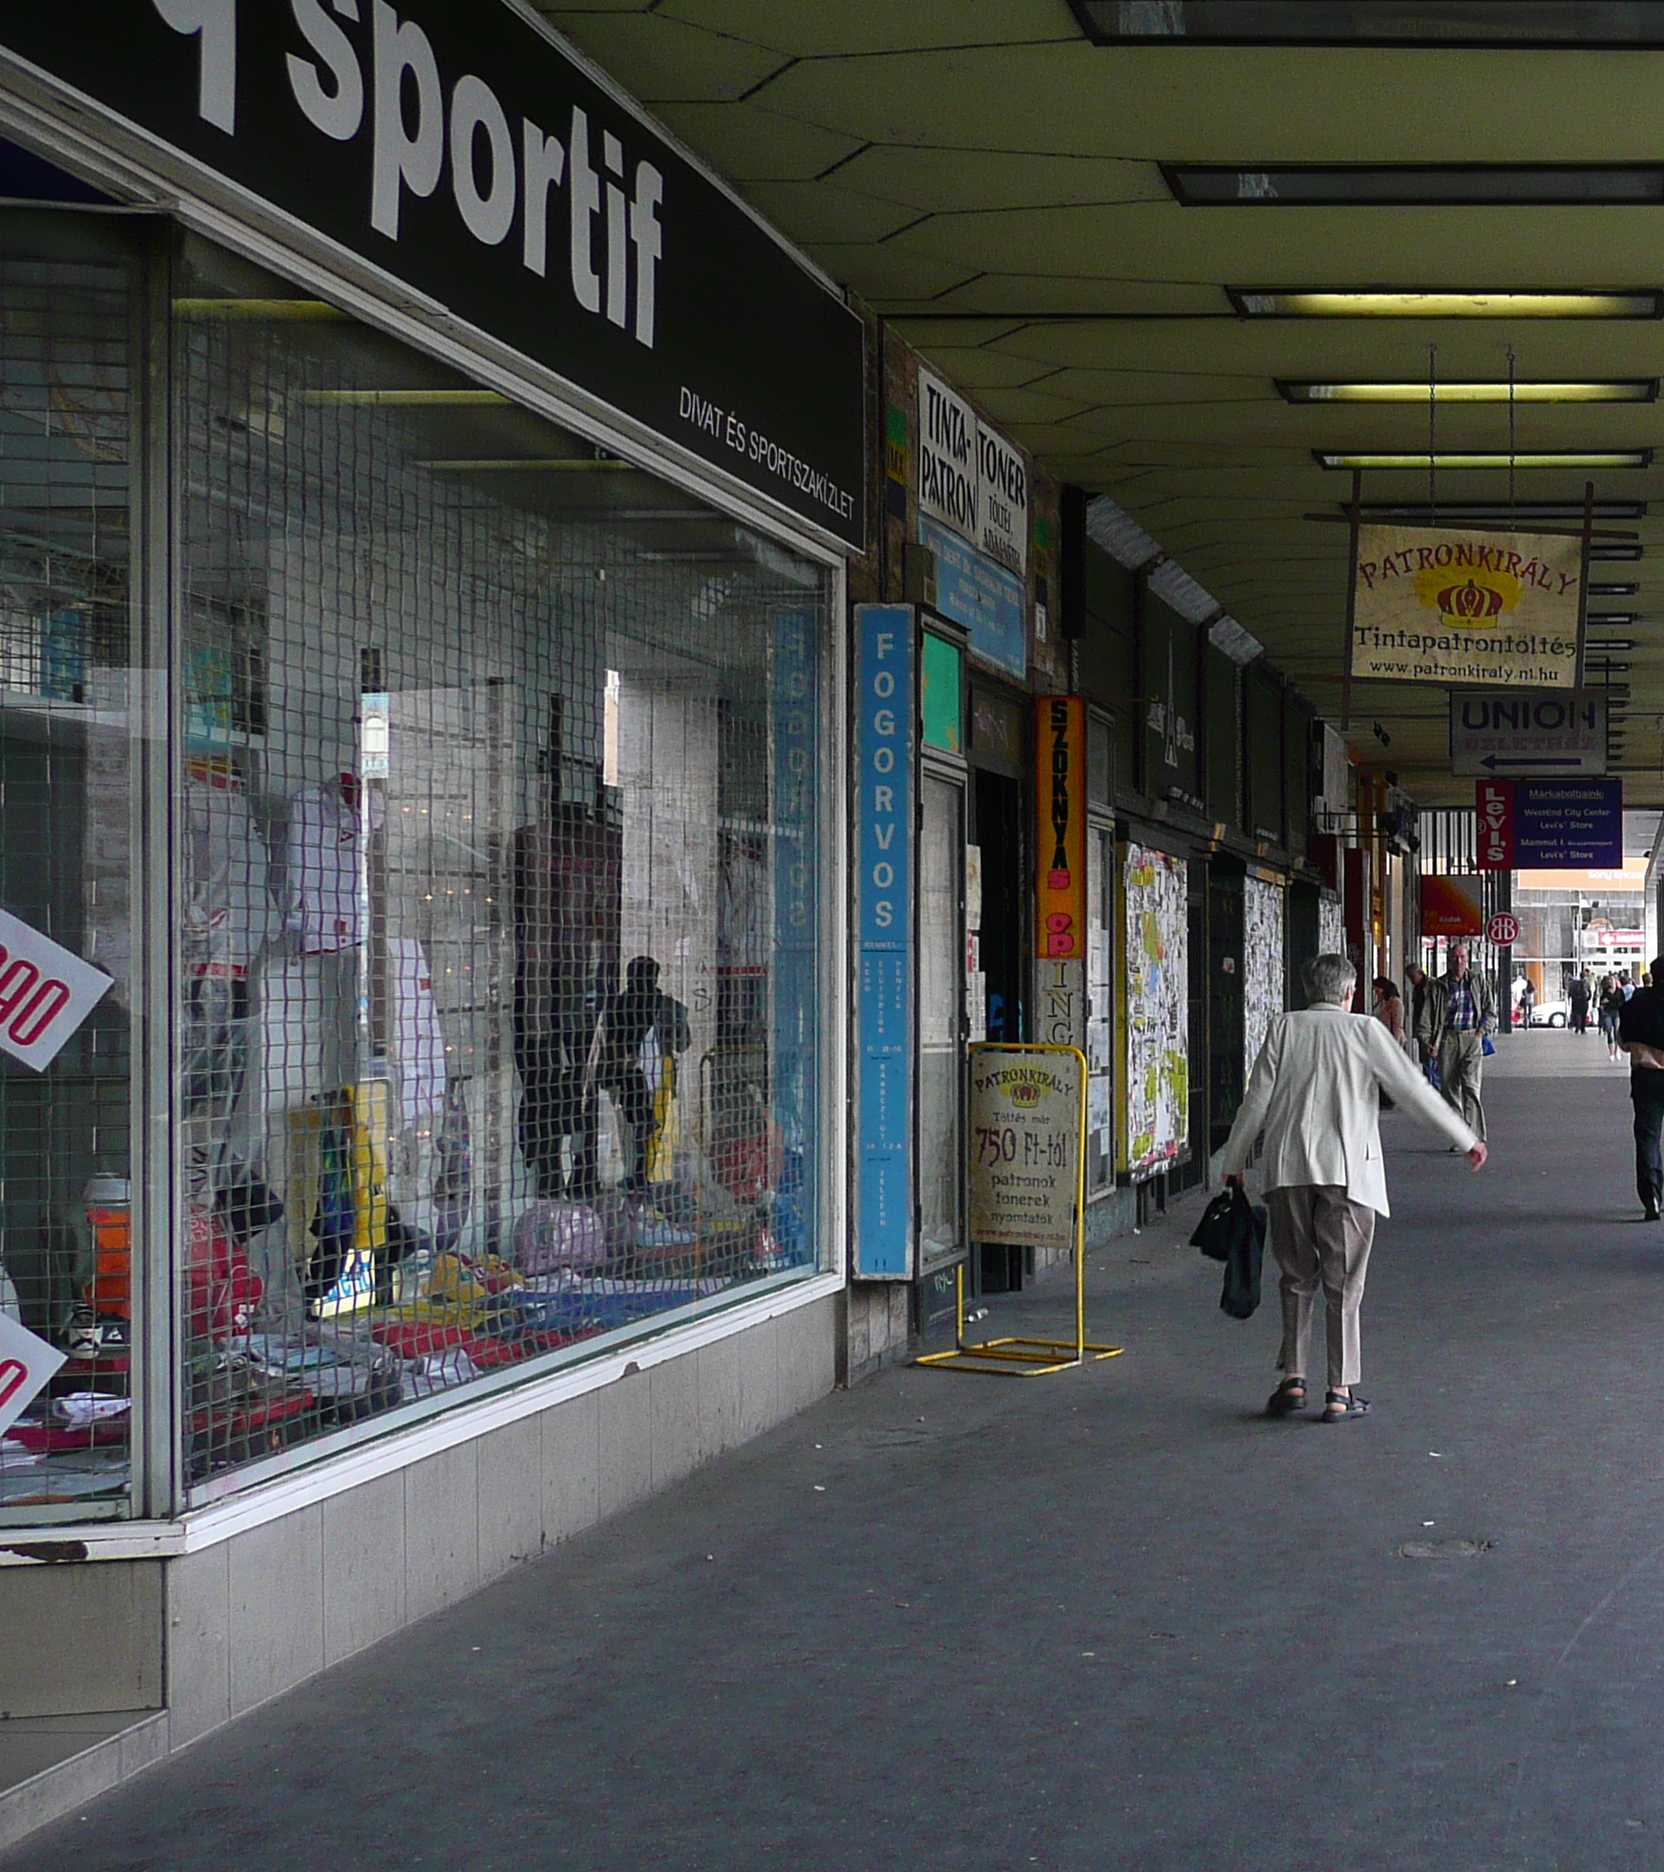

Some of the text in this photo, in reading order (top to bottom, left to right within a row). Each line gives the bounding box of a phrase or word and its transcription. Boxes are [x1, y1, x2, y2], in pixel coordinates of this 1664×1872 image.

[286, 0, 664, 349] sportif
[680, 386, 723, 438] DIVAT
[726, 411, 746, 452] ÉS
[922, 445, 976, 532] PATRON
[978, 430, 1026, 510] TONER
[1359, 544, 1578, 596] PATRONKIRÁLY
[1355, 626, 1576, 659] Tintapatrontöltés
[1462, 701, 1595, 730] UNION
[873, 633, 895, 928] FOGORVOS
[1051, 700, 1069, 869] SZOKNYA
[1524, 808, 1610, 818] WestEnd City Center
[1570, 821, 1593, 829] Store
[1521, 838, 1557, 846] Mammut
[1570, 851, 1593, 859] Store
[975, 1126, 1017, 1167] 750
[992, 1173, 1056, 1188] patronok
[996, 1192, 1050, 1208] tonerek
